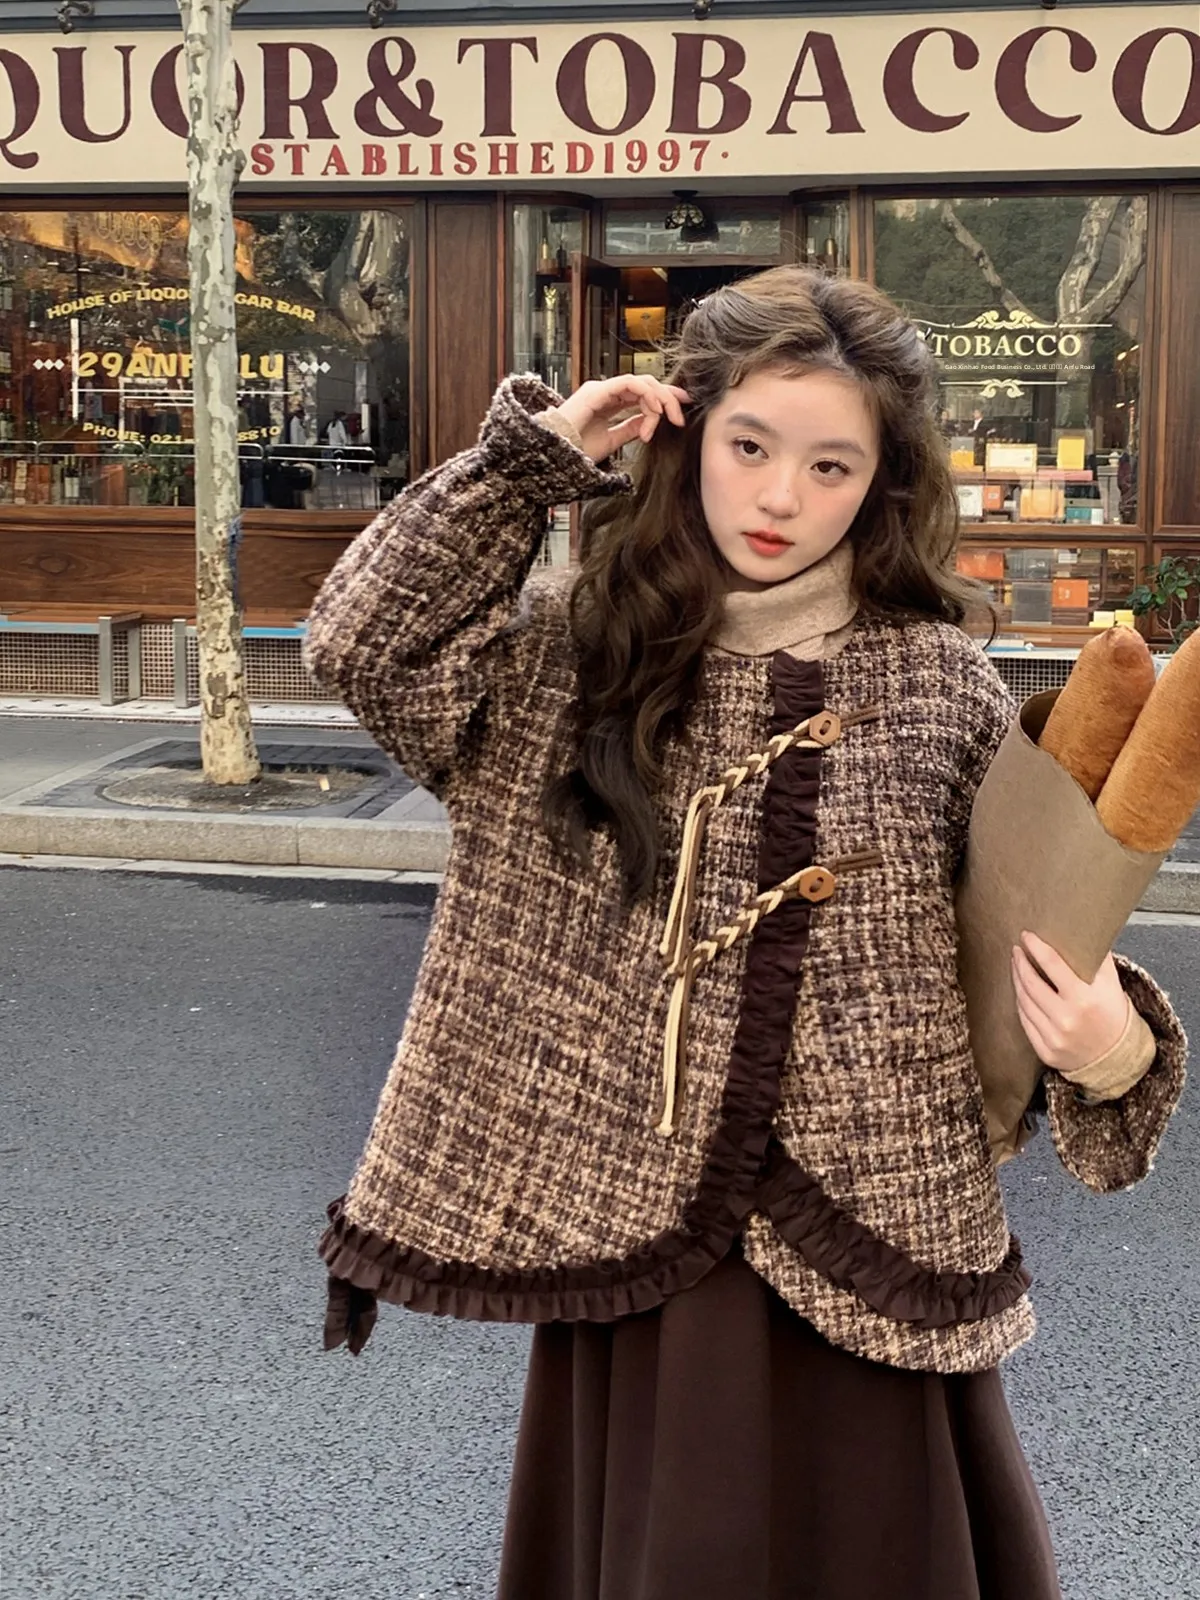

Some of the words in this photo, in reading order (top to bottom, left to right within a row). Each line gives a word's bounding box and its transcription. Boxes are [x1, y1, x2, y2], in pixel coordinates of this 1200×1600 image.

[46, 294, 106, 320] HOUSE
[109, 290, 133, 304] OF
[136, 287, 192, 302] LIQUO
[233, 292, 274, 310] GAR
[275, 299, 317, 323] BAR
[930, 333, 1082, 356] TOBACCO
[980, 363, 996, 371] Food
[996, 363, 1022, 371] Business
[1080, 363, 1096, 371] Road
[82, 422, 146, 443] PHONE:
